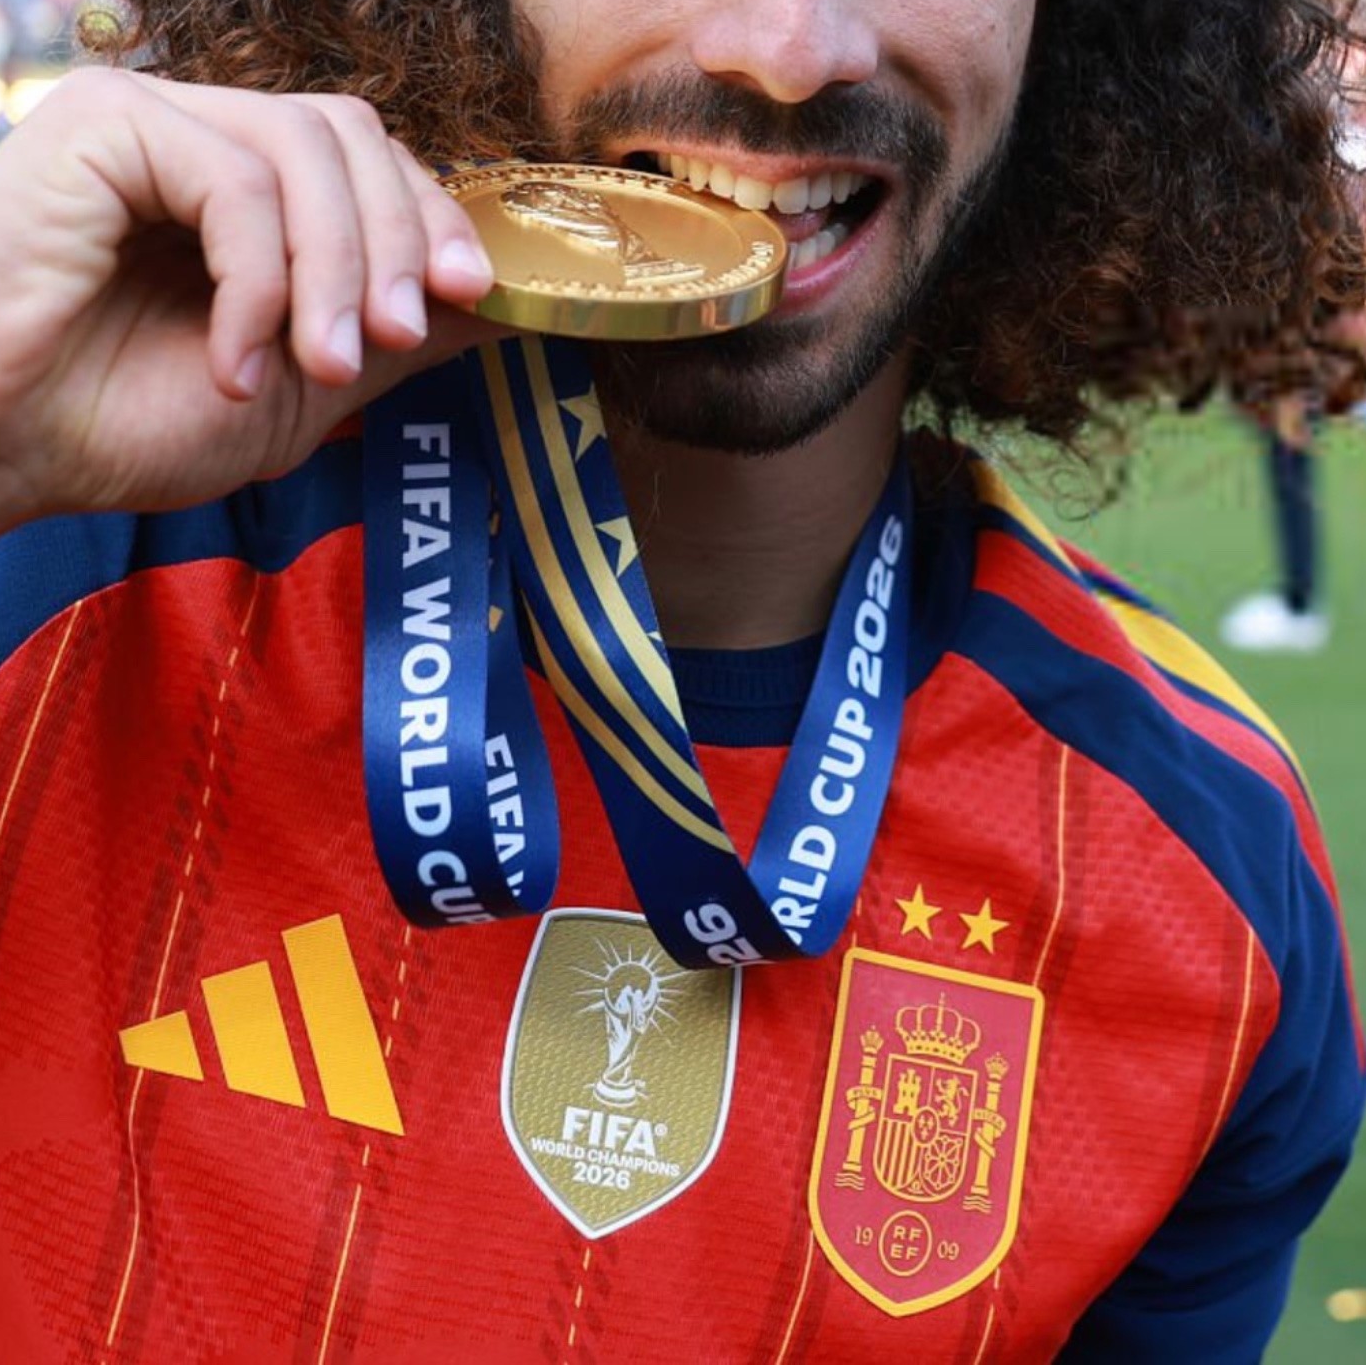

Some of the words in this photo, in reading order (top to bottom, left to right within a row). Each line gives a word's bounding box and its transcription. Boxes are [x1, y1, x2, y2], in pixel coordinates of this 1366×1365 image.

[402, 422, 451, 569] FIFA
[399, 576, 452, 837] WORLD
[770, 824, 837, 947] RLD
[809, 697, 874, 816] CUP
[846, 514, 904, 699] 2026
[531, 1137, 586, 1160] WORLD
[587, 1148, 681, 1177] CHAMPIONS
[572, 1161, 632, 1190] 2026
[855, 1225, 874, 1246] 19
[936, 1239, 960, 1261] 09
